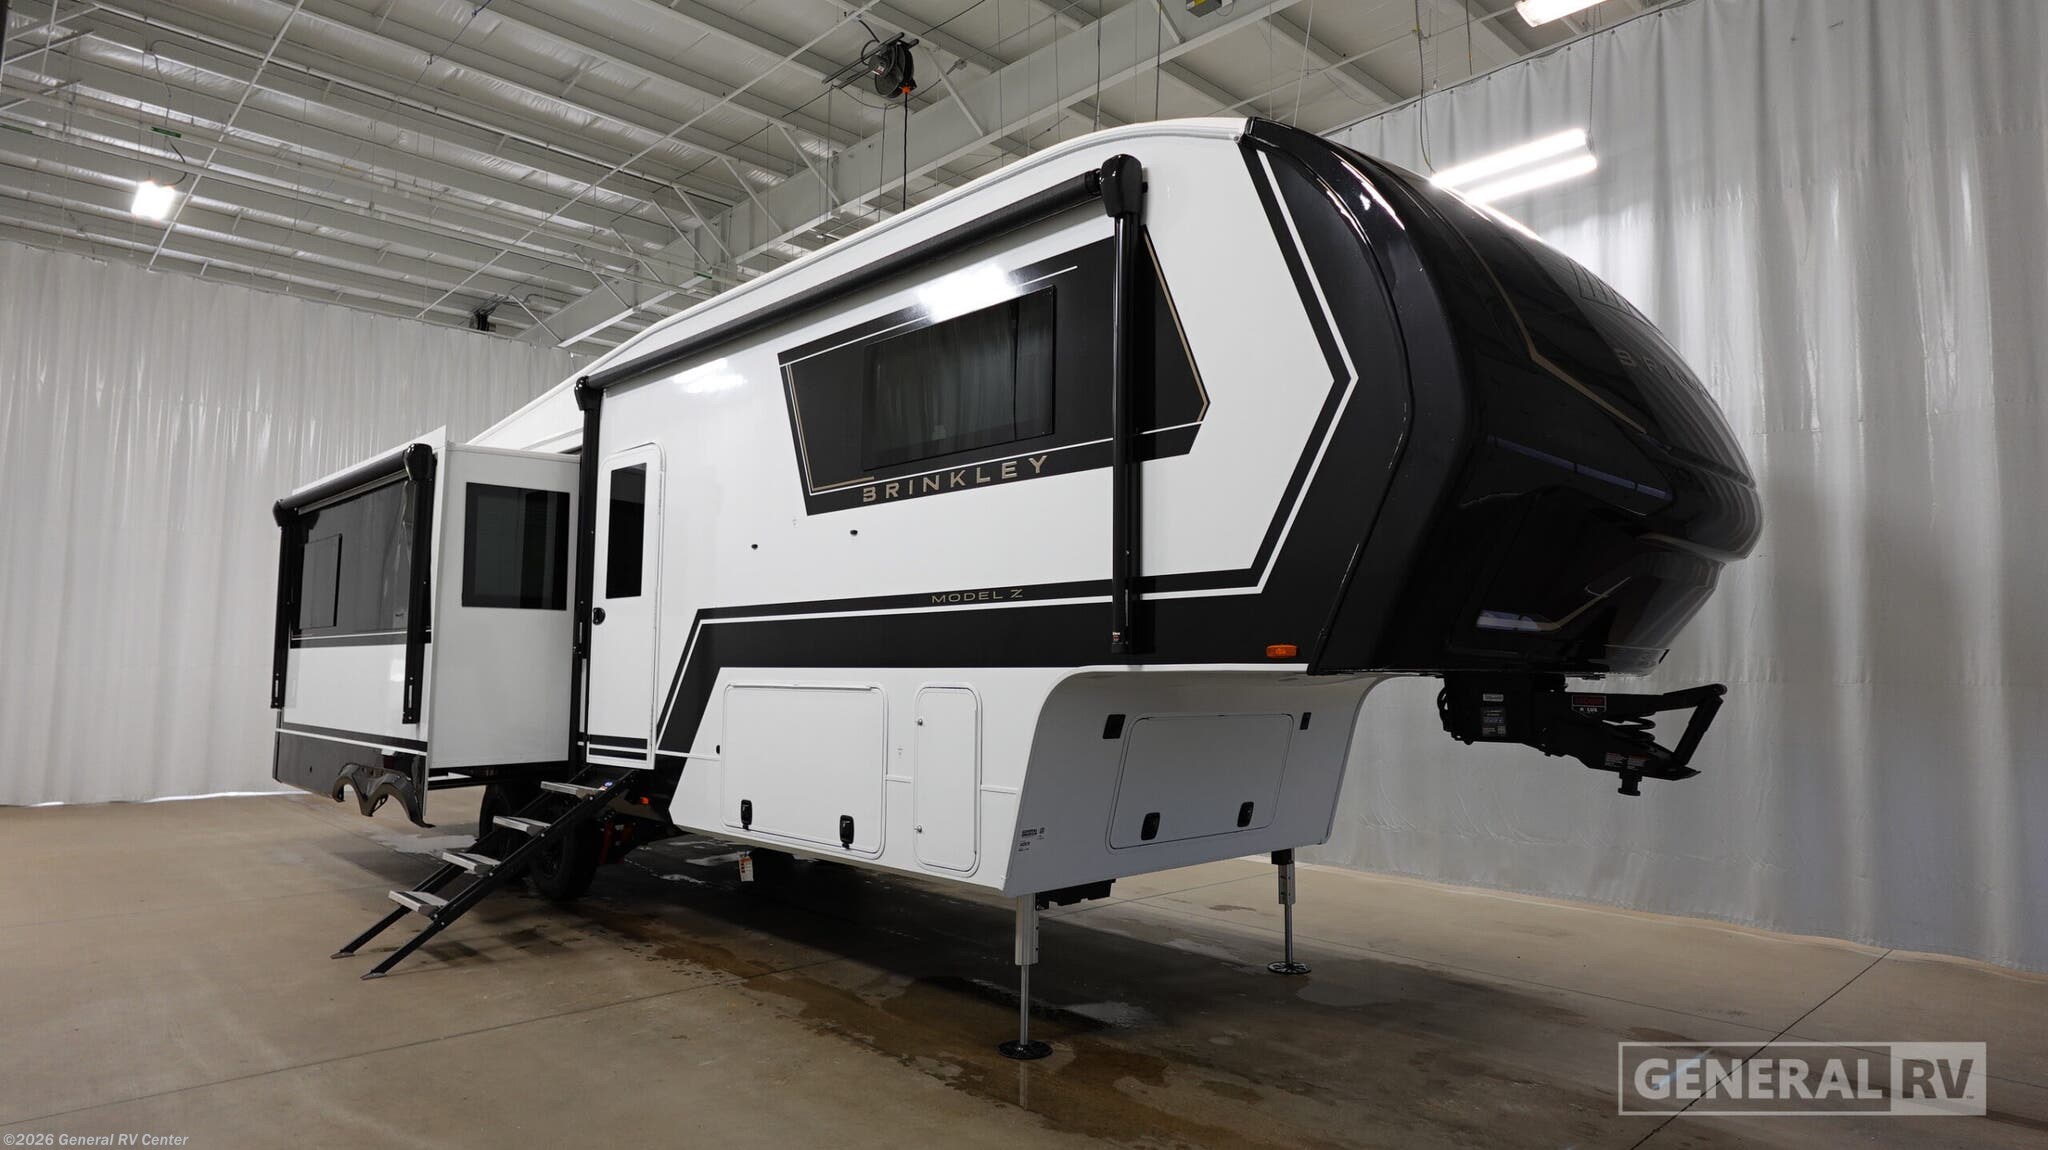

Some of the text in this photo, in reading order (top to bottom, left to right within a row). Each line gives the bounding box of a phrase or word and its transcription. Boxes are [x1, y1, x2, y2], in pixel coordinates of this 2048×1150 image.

[863, 455, 1048, 502] BRINKLEY
[931, 589, 1023, 604] MODEL Z
